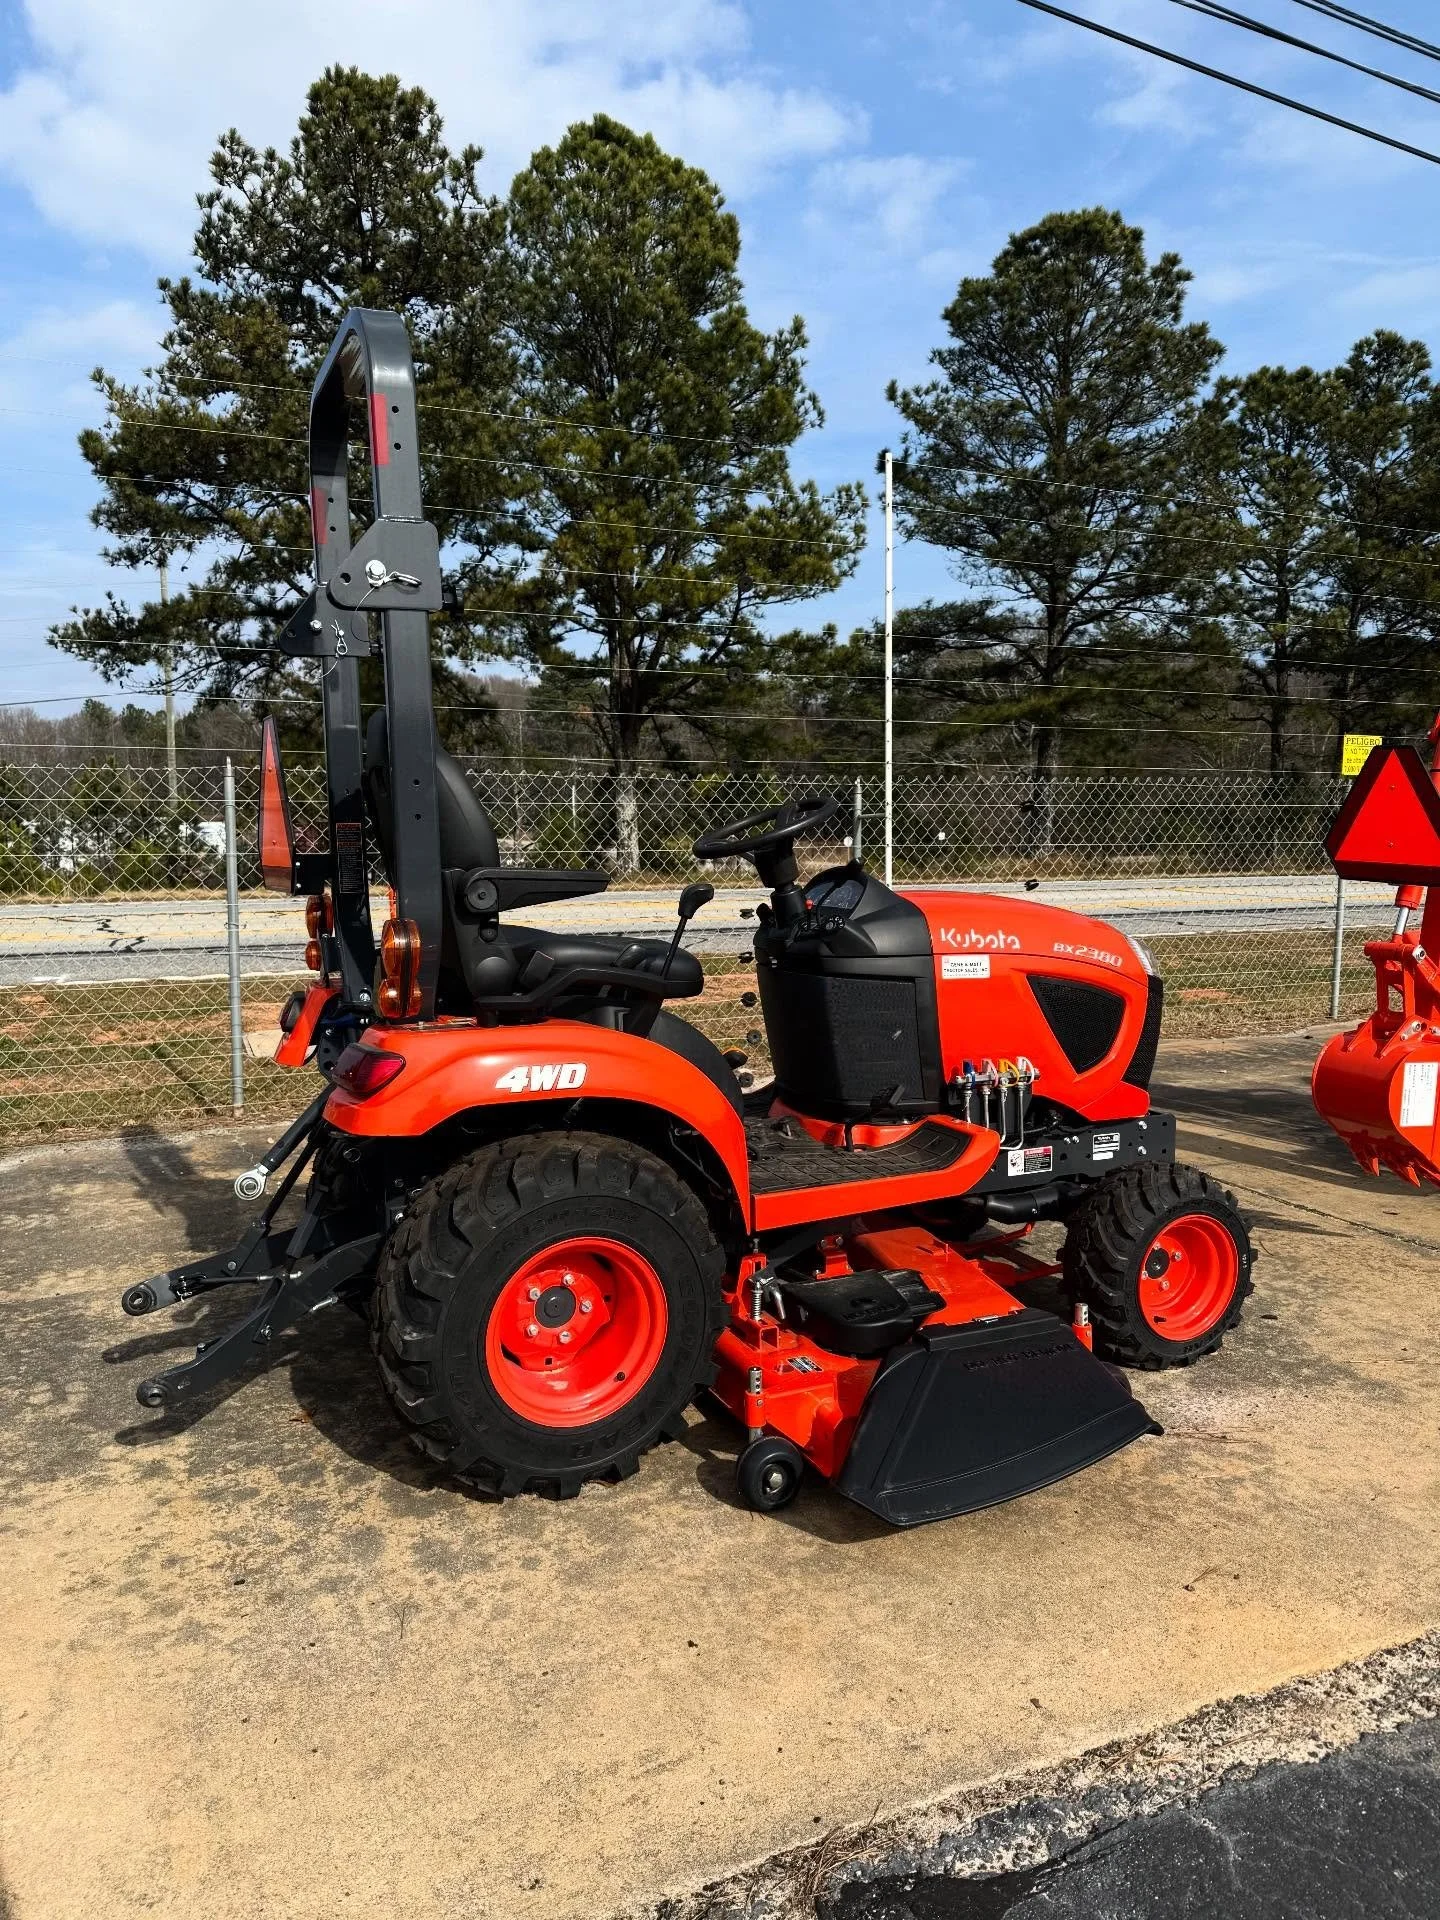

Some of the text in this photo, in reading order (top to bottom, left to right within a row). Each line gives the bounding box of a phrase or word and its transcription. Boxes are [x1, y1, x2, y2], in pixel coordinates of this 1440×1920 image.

[941, 928, 1020, 949] Kubota
[1053, 942, 1123, 967] BX2380
[495, 1062, 587, 1093] 4WD
